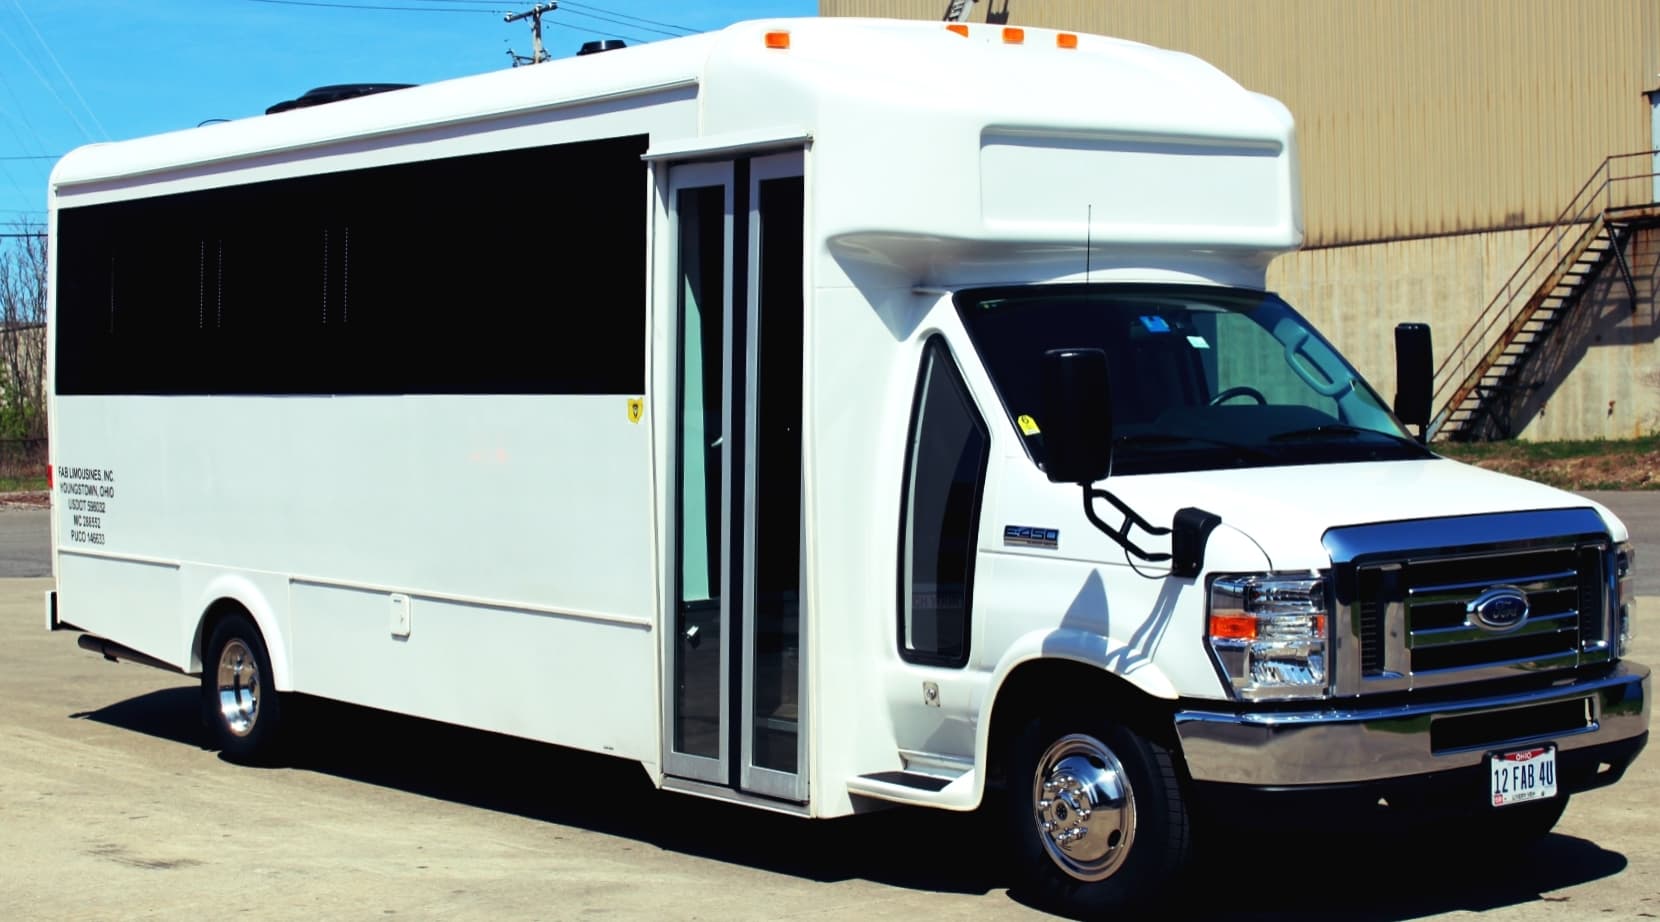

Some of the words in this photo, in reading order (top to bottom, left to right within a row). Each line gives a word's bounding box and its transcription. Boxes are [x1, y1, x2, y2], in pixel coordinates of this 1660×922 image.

[58, 466, 69, 478] FAB
[100, 485, 115, 499] OHIO
[1515, 752, 1532, 760] OHIO
[1494, 768, 1508, 793] 12
[1513, 763, 1535, 792] FAB
[1539, 760, 1554, 786] 4U
